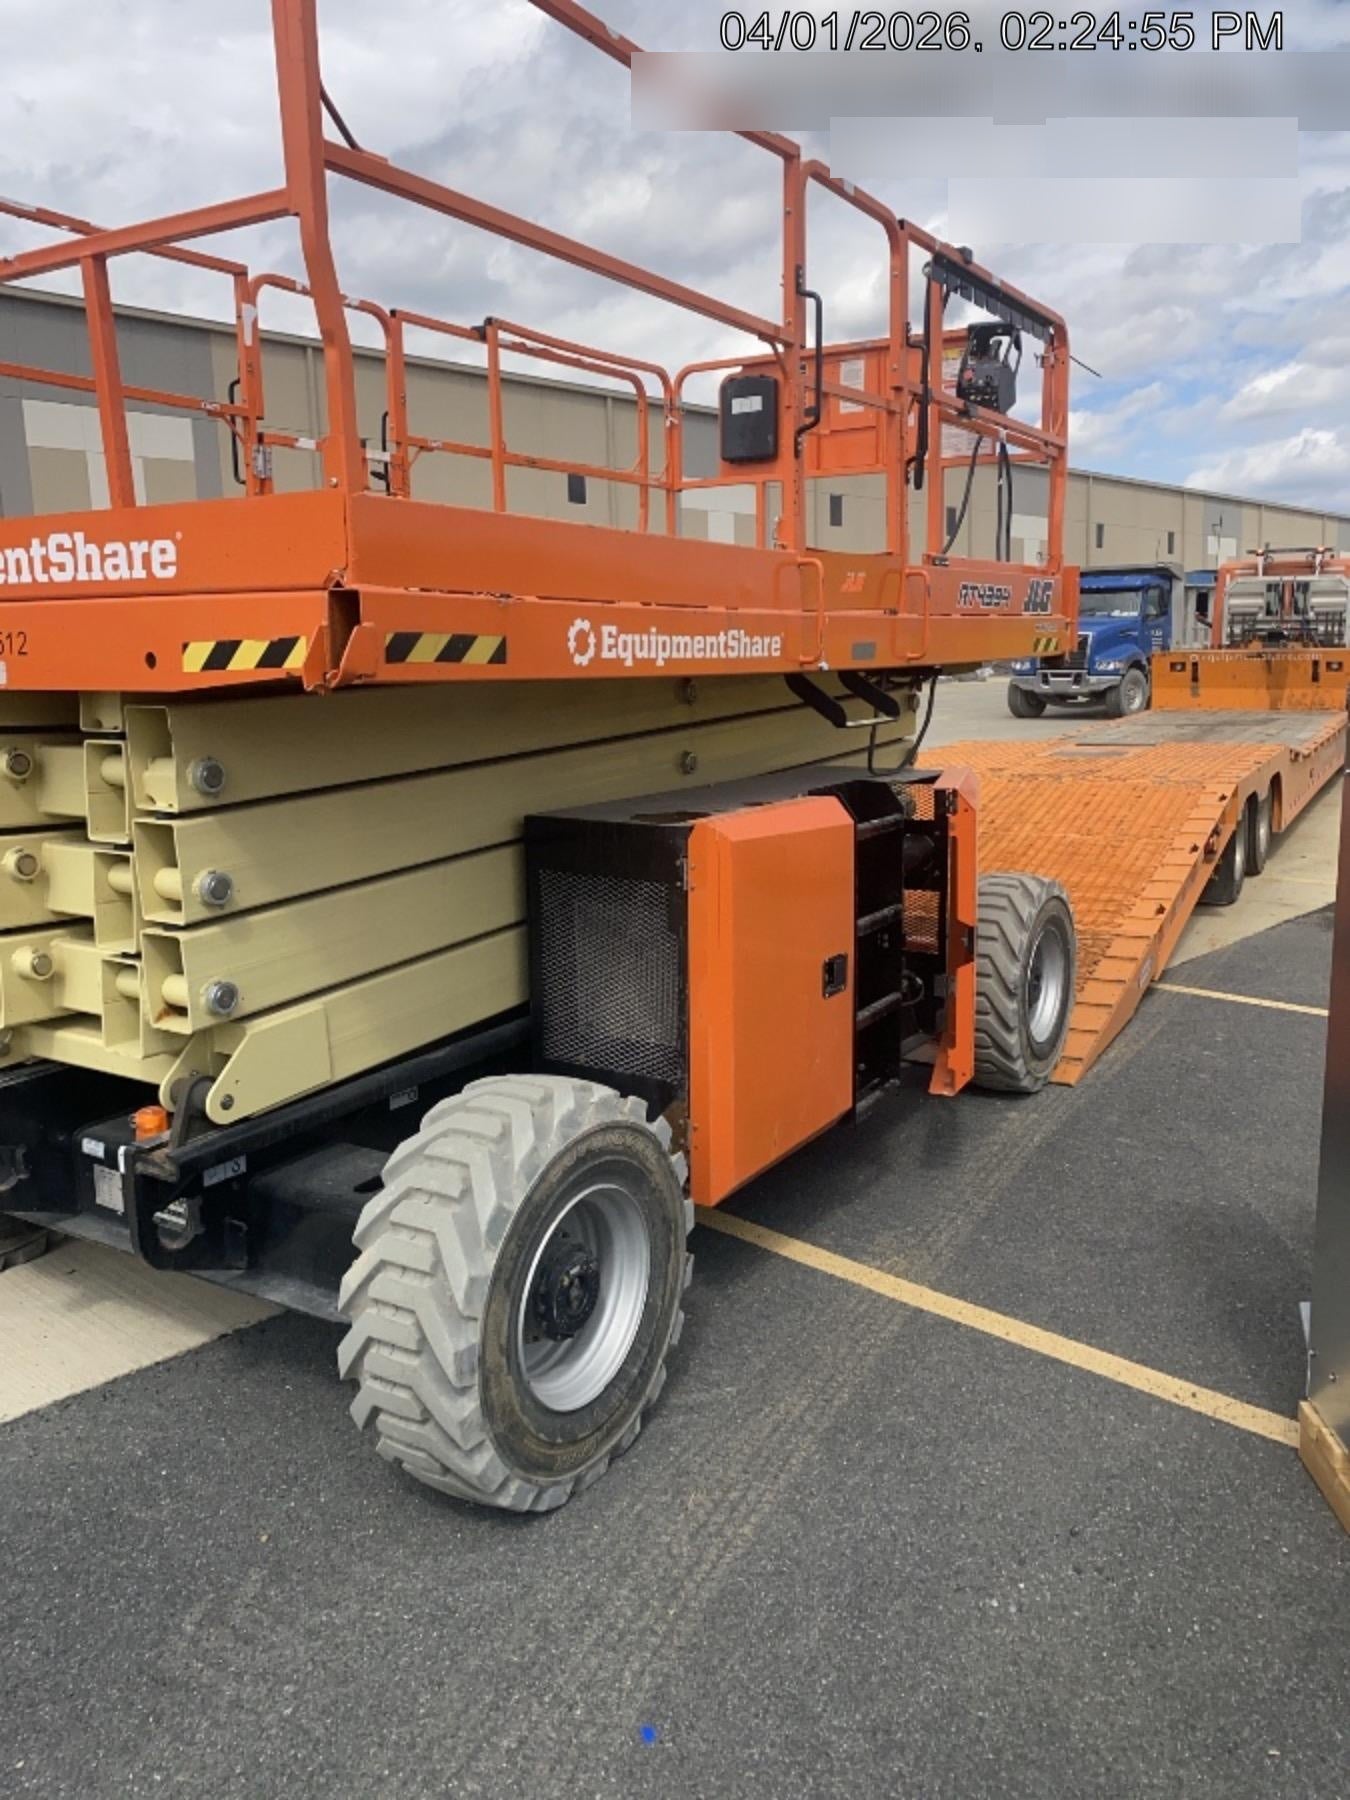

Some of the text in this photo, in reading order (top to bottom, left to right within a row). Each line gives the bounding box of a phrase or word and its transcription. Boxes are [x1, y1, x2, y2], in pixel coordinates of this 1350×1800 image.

[0, 531, 177, 585] ntShare
[1022, 578, 1055, 615] JLG
[601, 625, 782, 667] EquipmentShare
